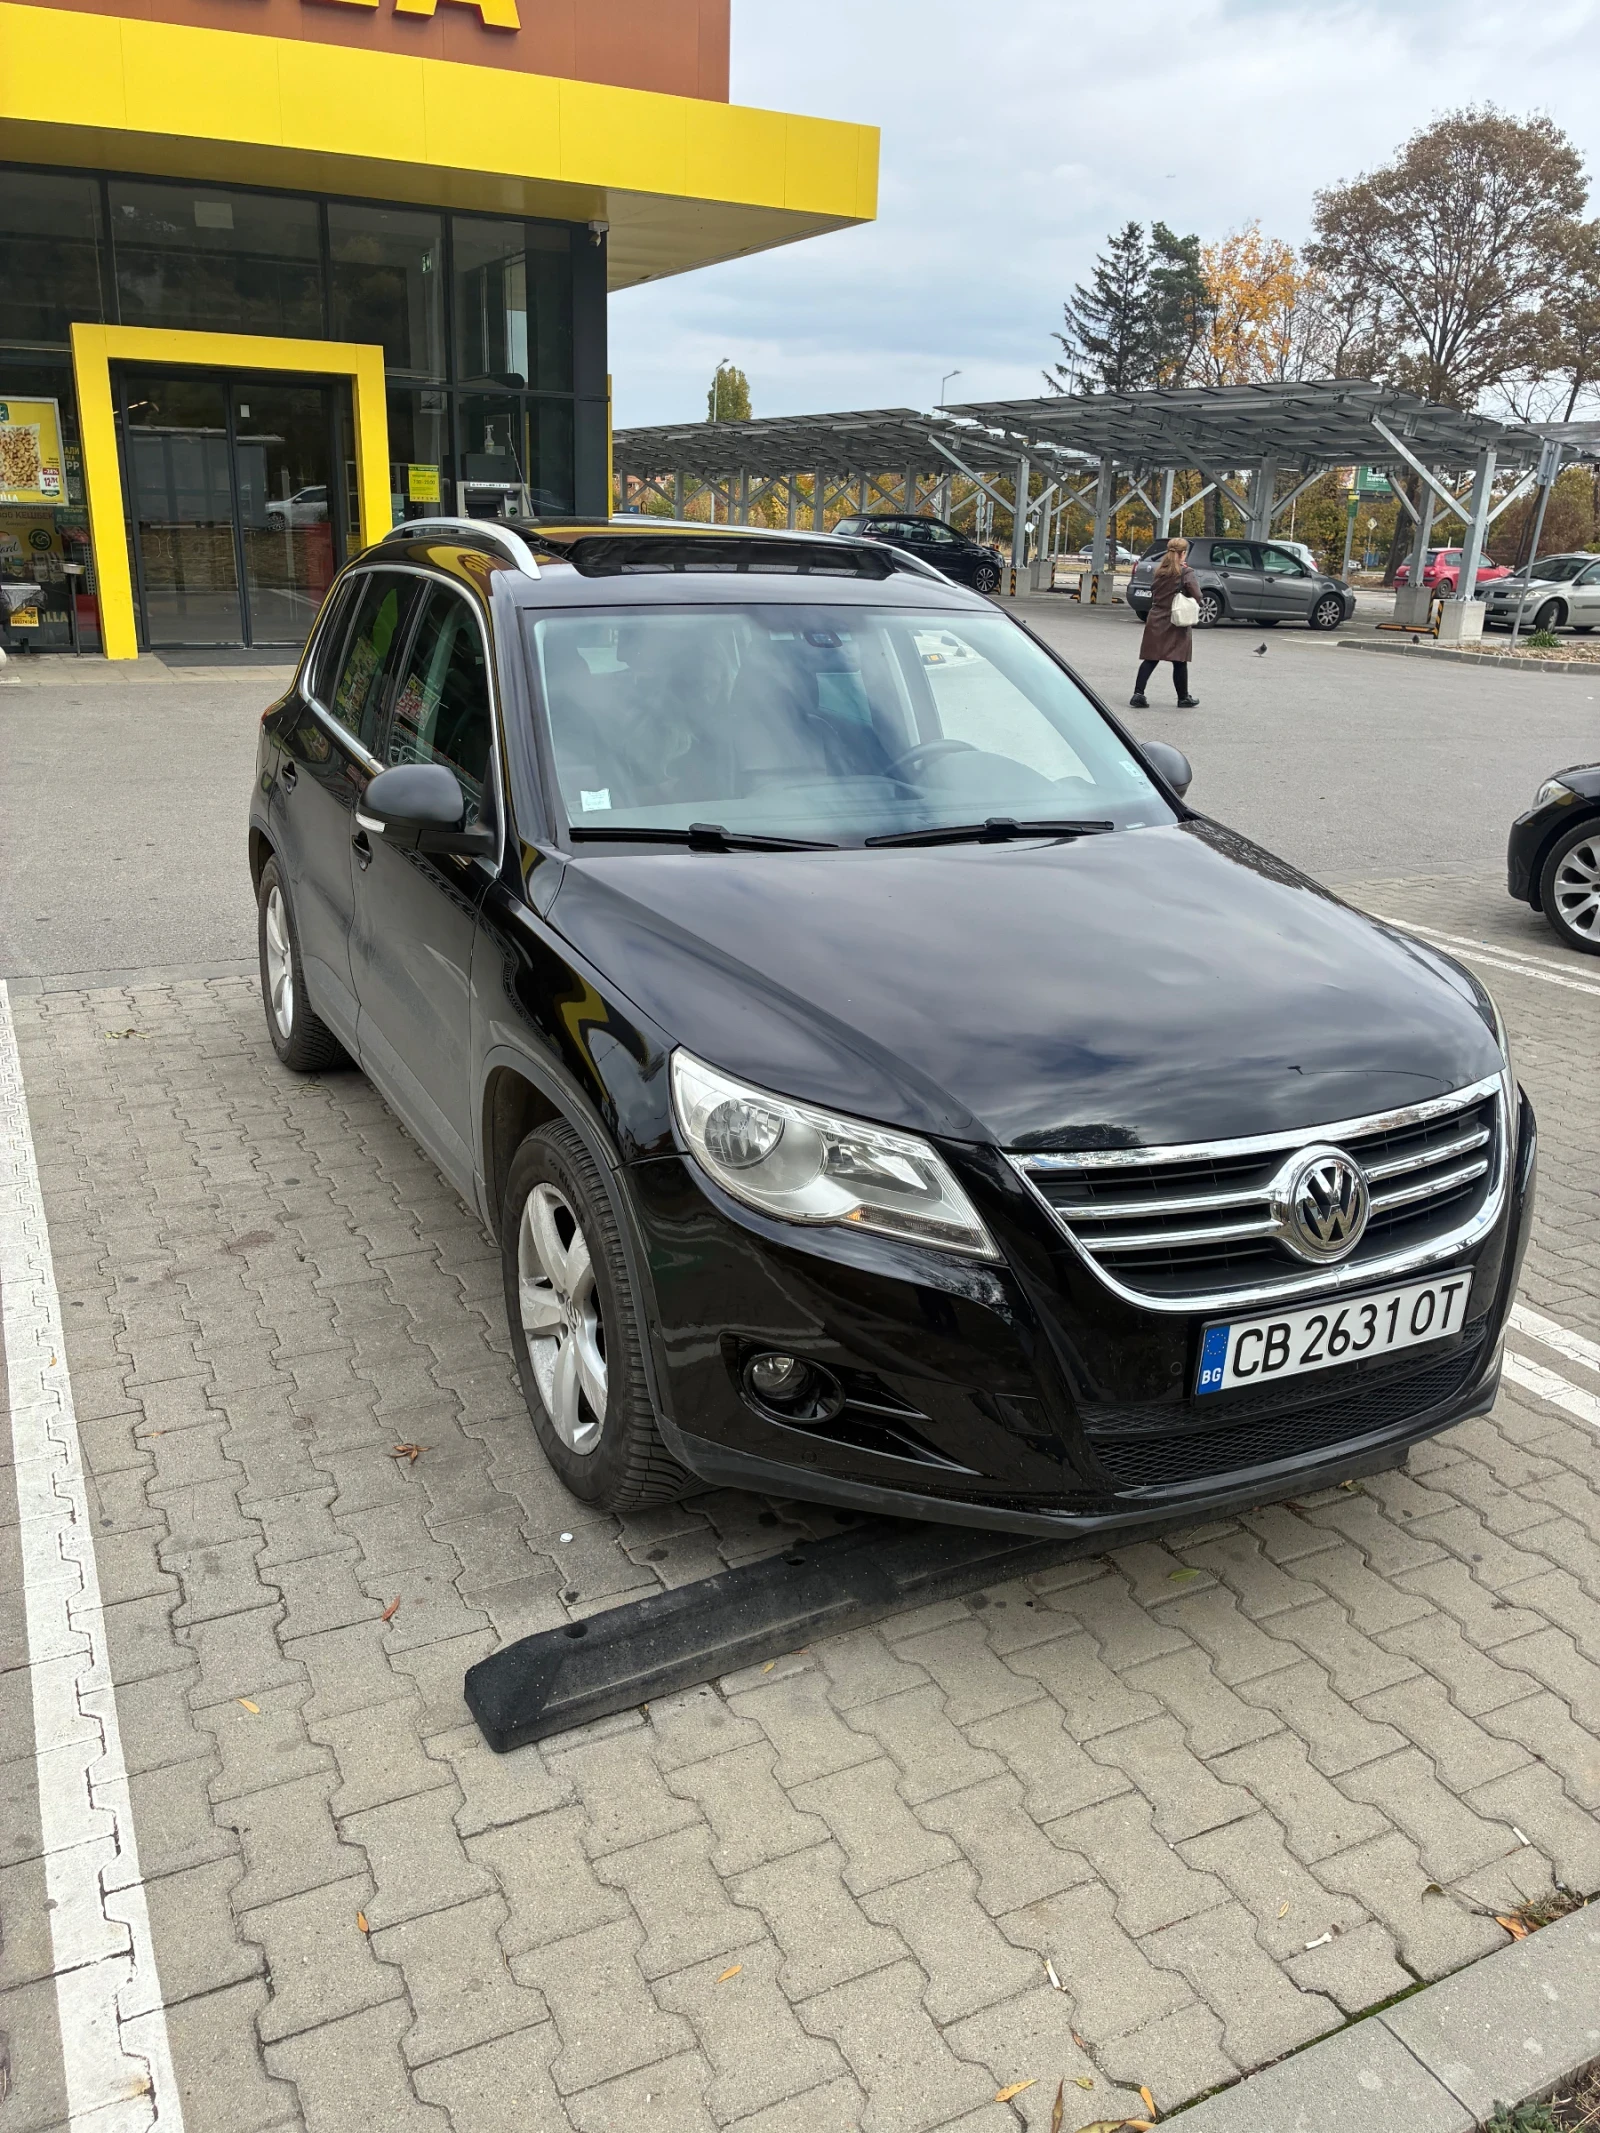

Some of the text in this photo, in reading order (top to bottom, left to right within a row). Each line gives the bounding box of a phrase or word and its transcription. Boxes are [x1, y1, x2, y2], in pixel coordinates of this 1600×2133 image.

[64, 446, 80, 455] АЛИ
[66, 461, 80, 471] PP
[0, 541, 19, 553] ard
[42, 611, 69, 622] ILLA
[1299, 1297, 1401, 1367] 2631
[1201, 1367, 1222, 1385] BG
